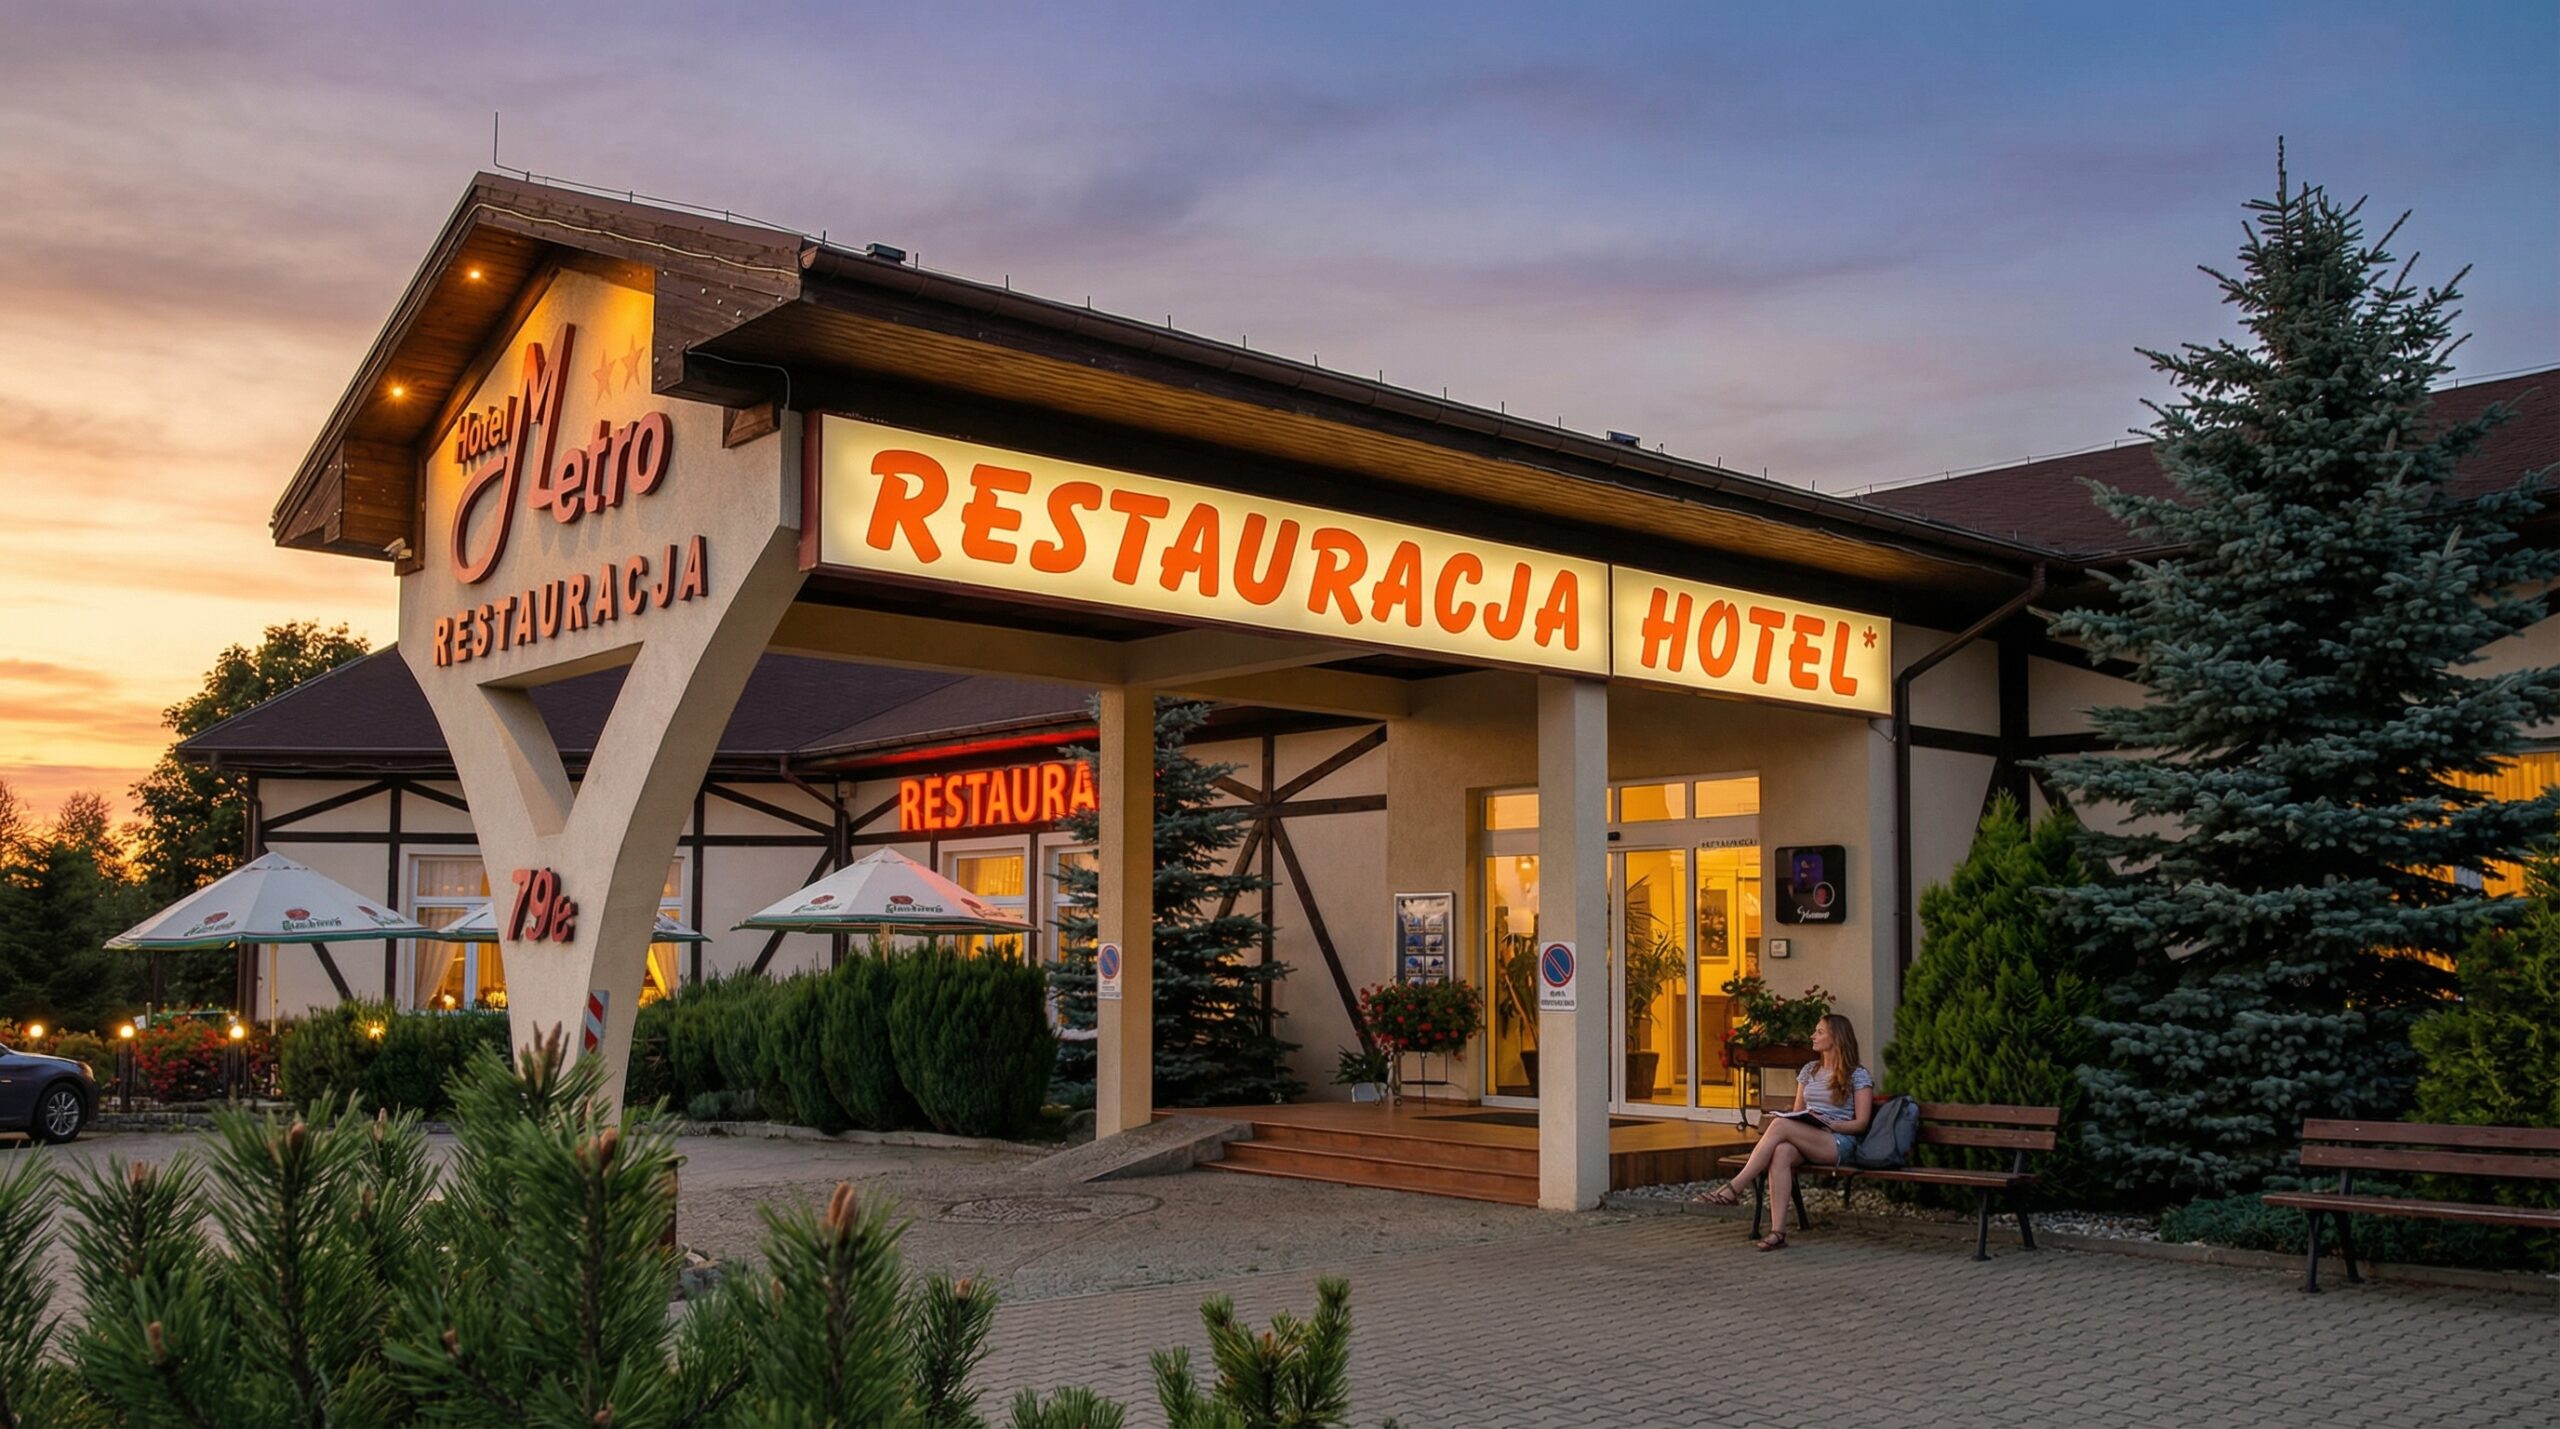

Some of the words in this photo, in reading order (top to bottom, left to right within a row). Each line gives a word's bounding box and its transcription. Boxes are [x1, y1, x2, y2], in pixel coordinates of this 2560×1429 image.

[451, 323, 672, 585] Metro
[454, 397, 516, 463] Hotel
[433, 535, 708, 666] RESTAURACJA
[866, 449, 1579, 651] RESTAURACJA
